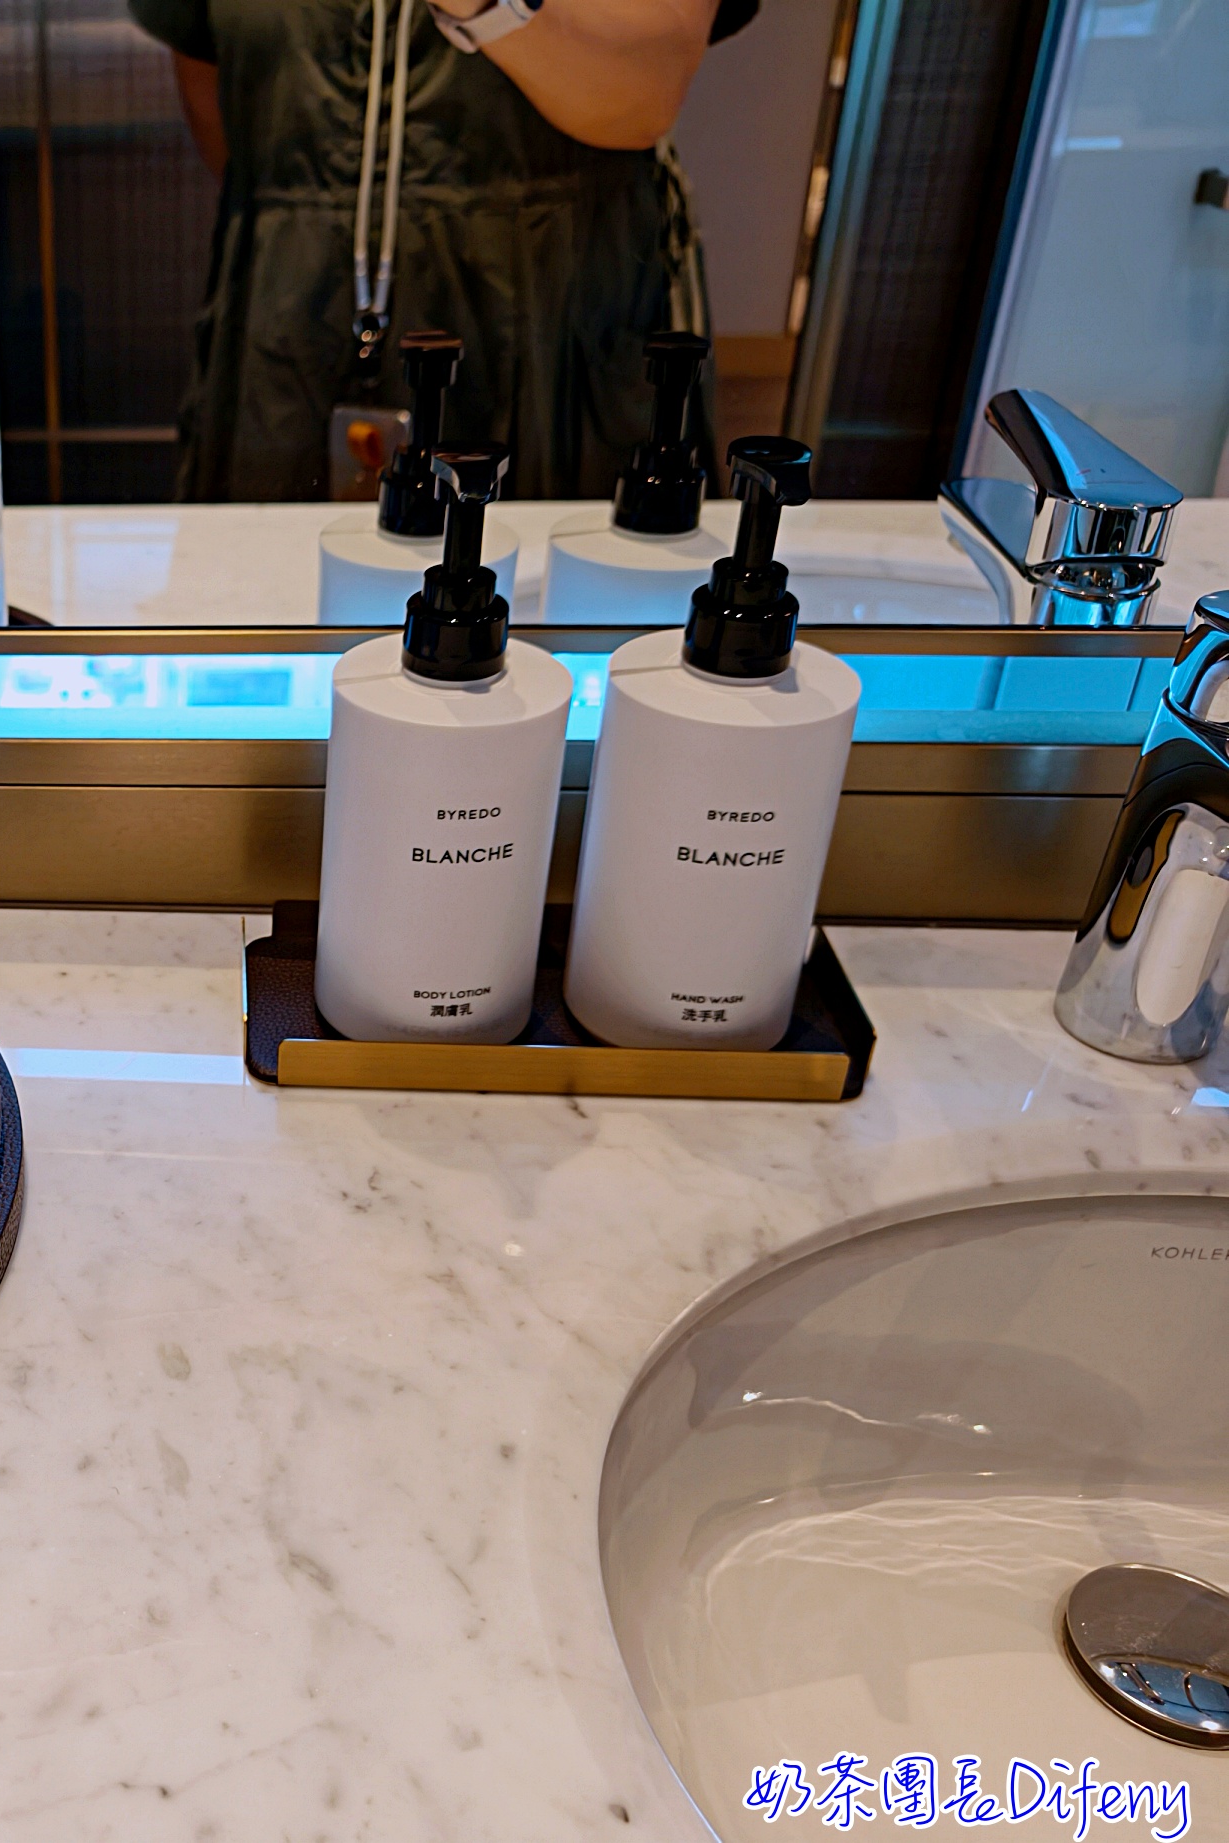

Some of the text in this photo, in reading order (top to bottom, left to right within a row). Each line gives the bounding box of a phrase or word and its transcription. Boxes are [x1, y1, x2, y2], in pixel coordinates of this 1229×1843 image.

[437, 807, 501, 820] BYREDO
[707, 810, 775, 822] BYREDO
[412, 843, 514, 864] BLANCHE
[677, 846, 786, 867] BLANCHE
[414, 986, 491, 999] BODY LOTION
[671, 992, 744, 1004] HAND WASH
[681, 1008, 728, 1022] 洗手乳
